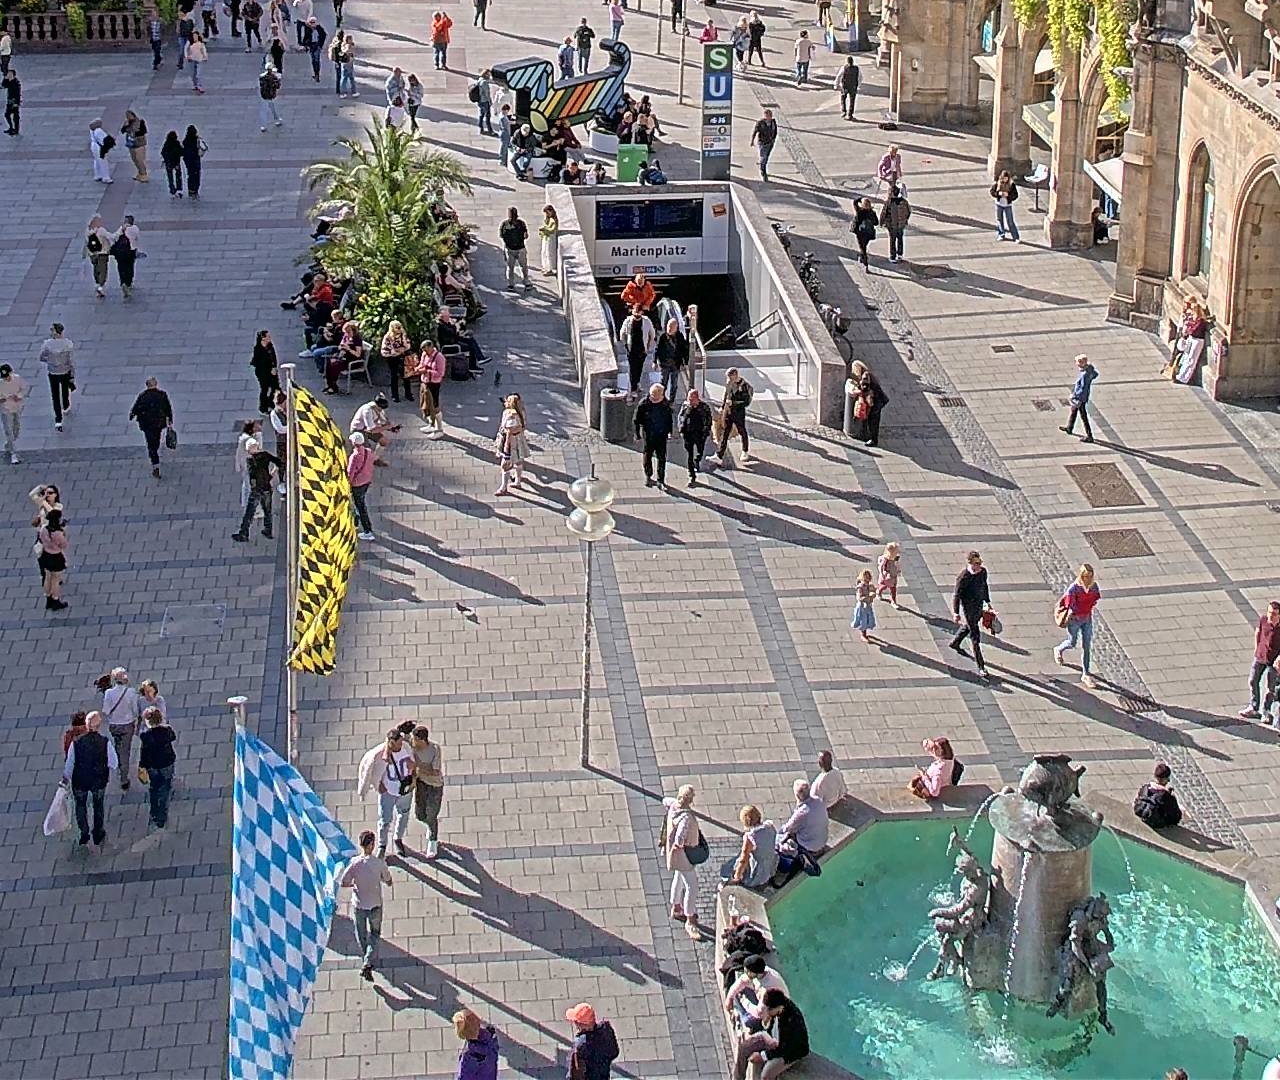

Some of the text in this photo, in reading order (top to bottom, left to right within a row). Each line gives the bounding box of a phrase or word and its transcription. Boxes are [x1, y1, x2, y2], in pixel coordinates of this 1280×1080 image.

[709, 47, 728, 70] S
[709, 75, 726, 97] U
[611, 245, 687, 258] Marienplatz
